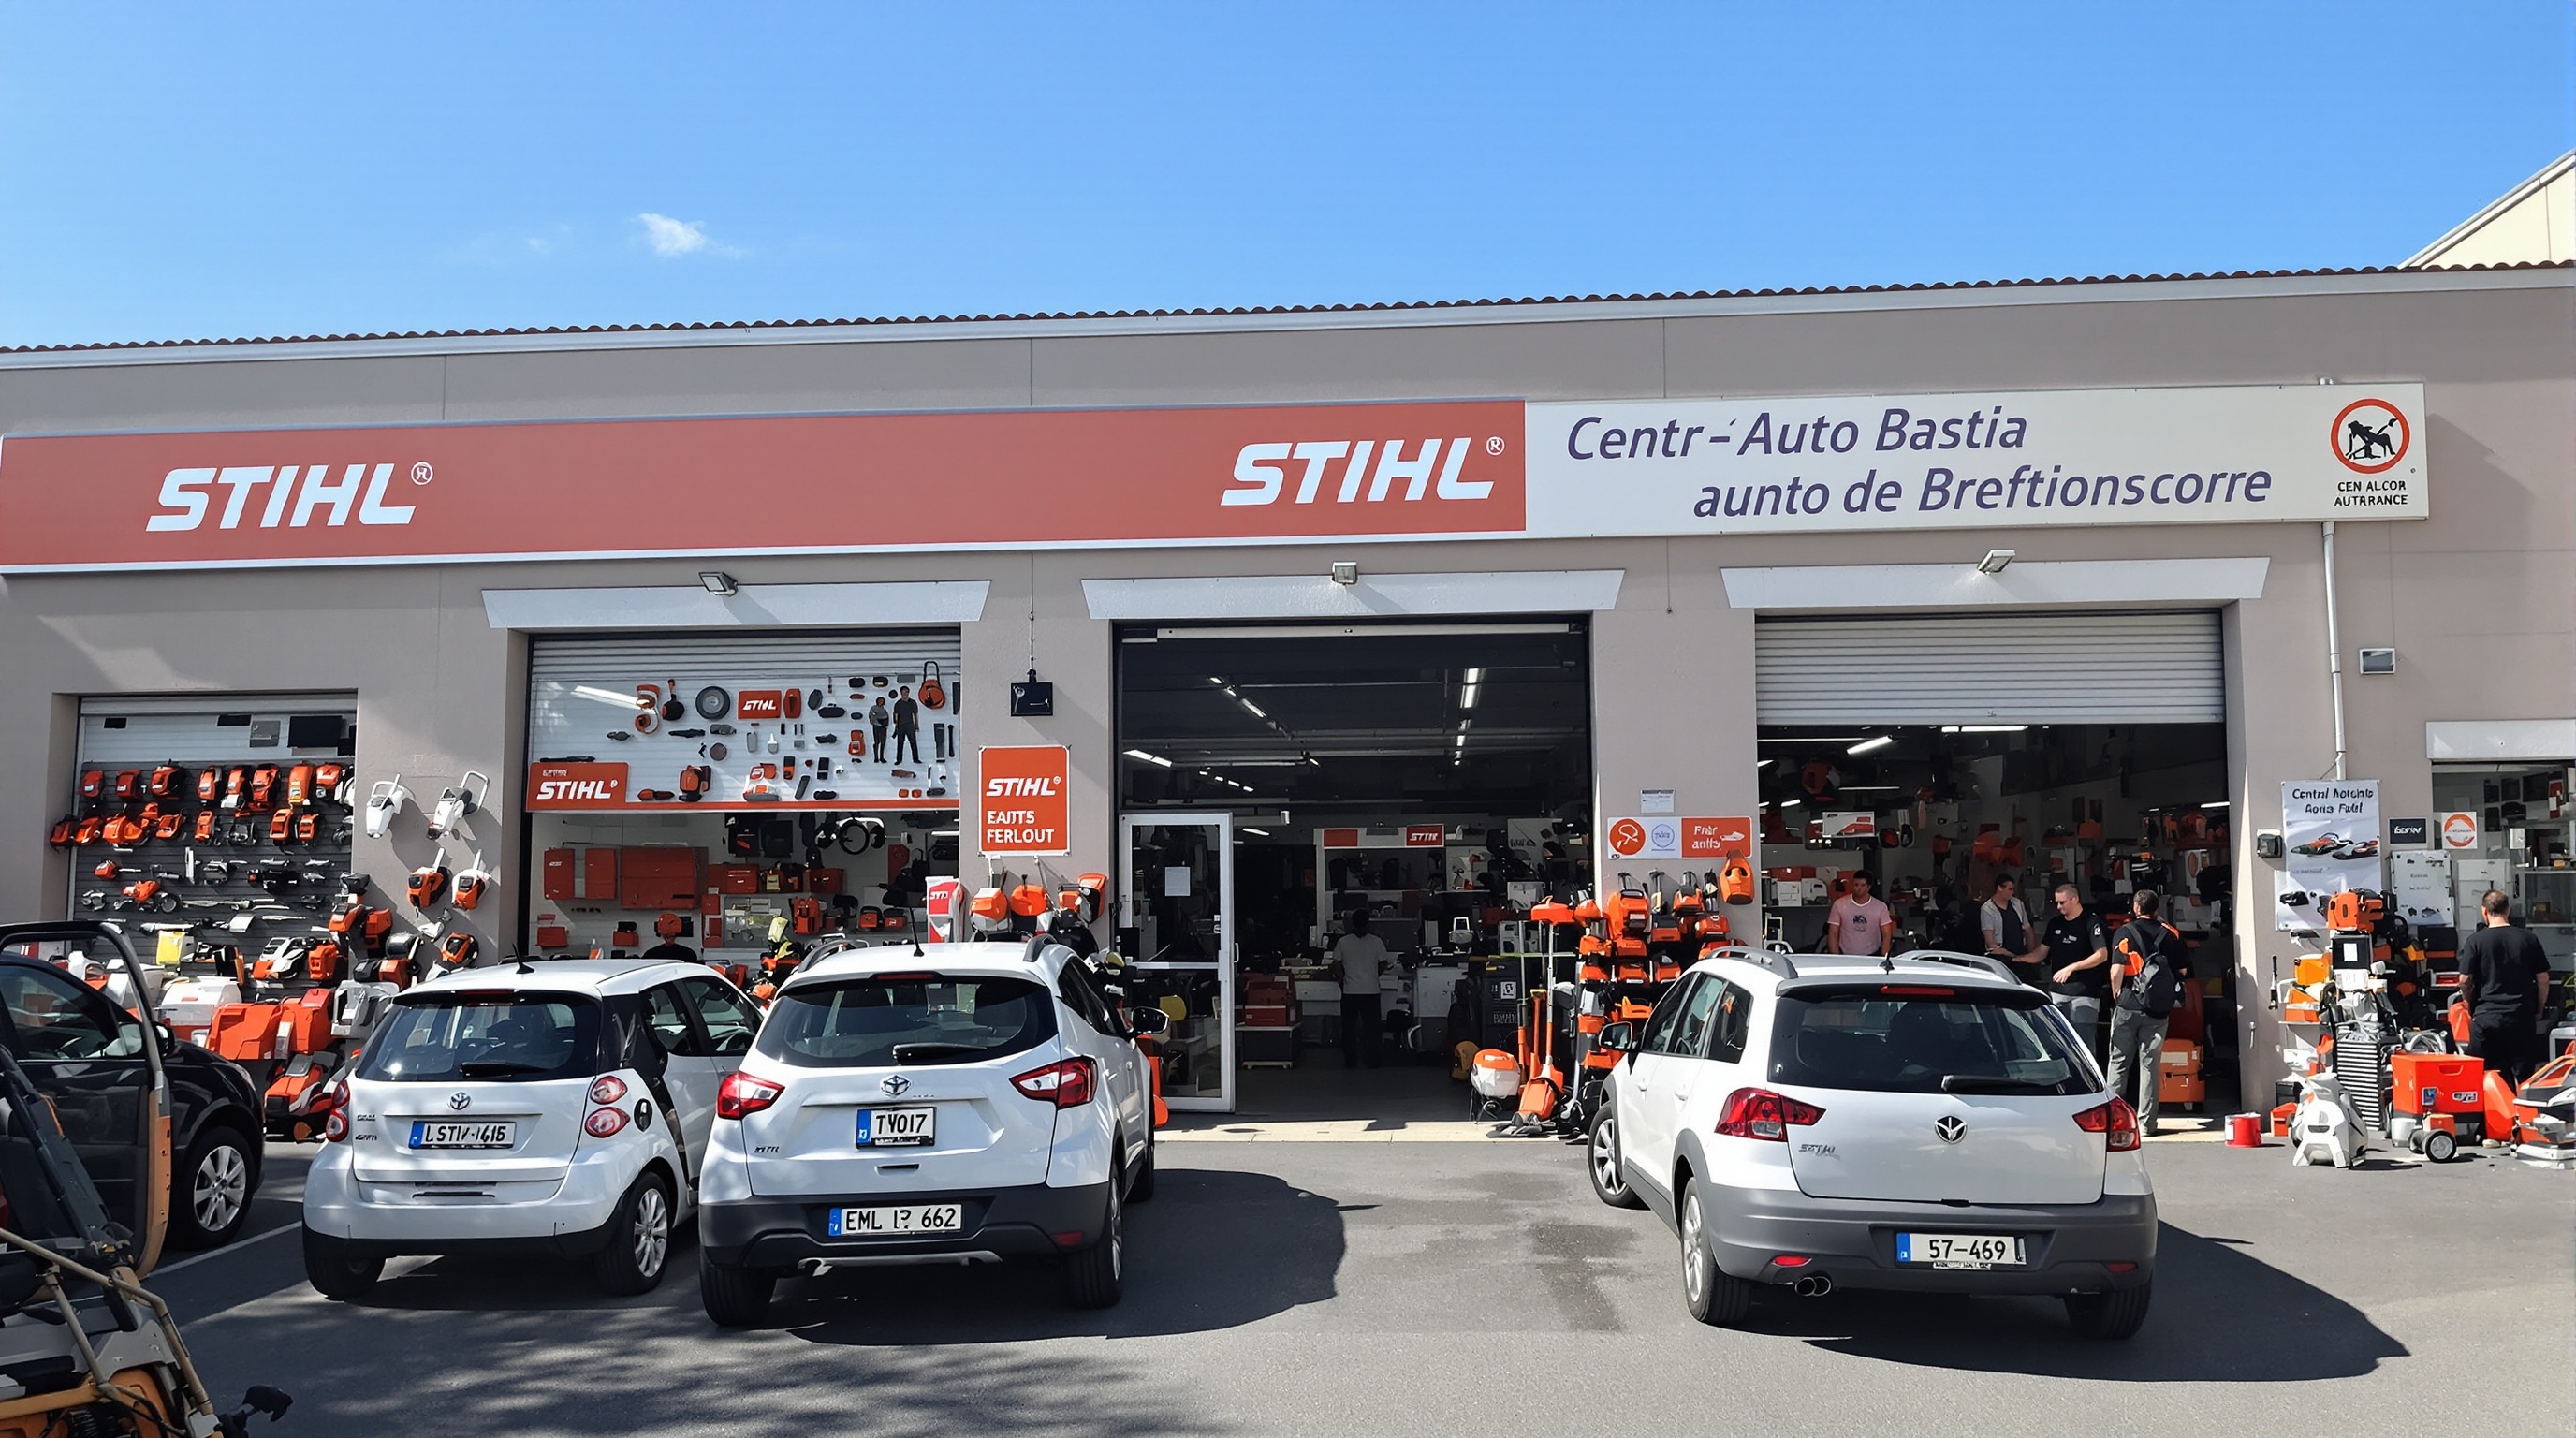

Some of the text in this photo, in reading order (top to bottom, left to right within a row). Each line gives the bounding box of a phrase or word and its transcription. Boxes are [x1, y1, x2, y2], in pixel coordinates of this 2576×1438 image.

[1875, 405, 2027, 452] Bastia
[1693, 464, 2273, 518] aunto de Breftionscorre
[2337, 481, 2362, 492] CEN
[987, 829, 1055, 844] FERLOUT
[845, 1210, 883, 1231] EML
[921, 1207, 957, 1228] 662
[1928, 1239, 2007, 1261] 57-469
